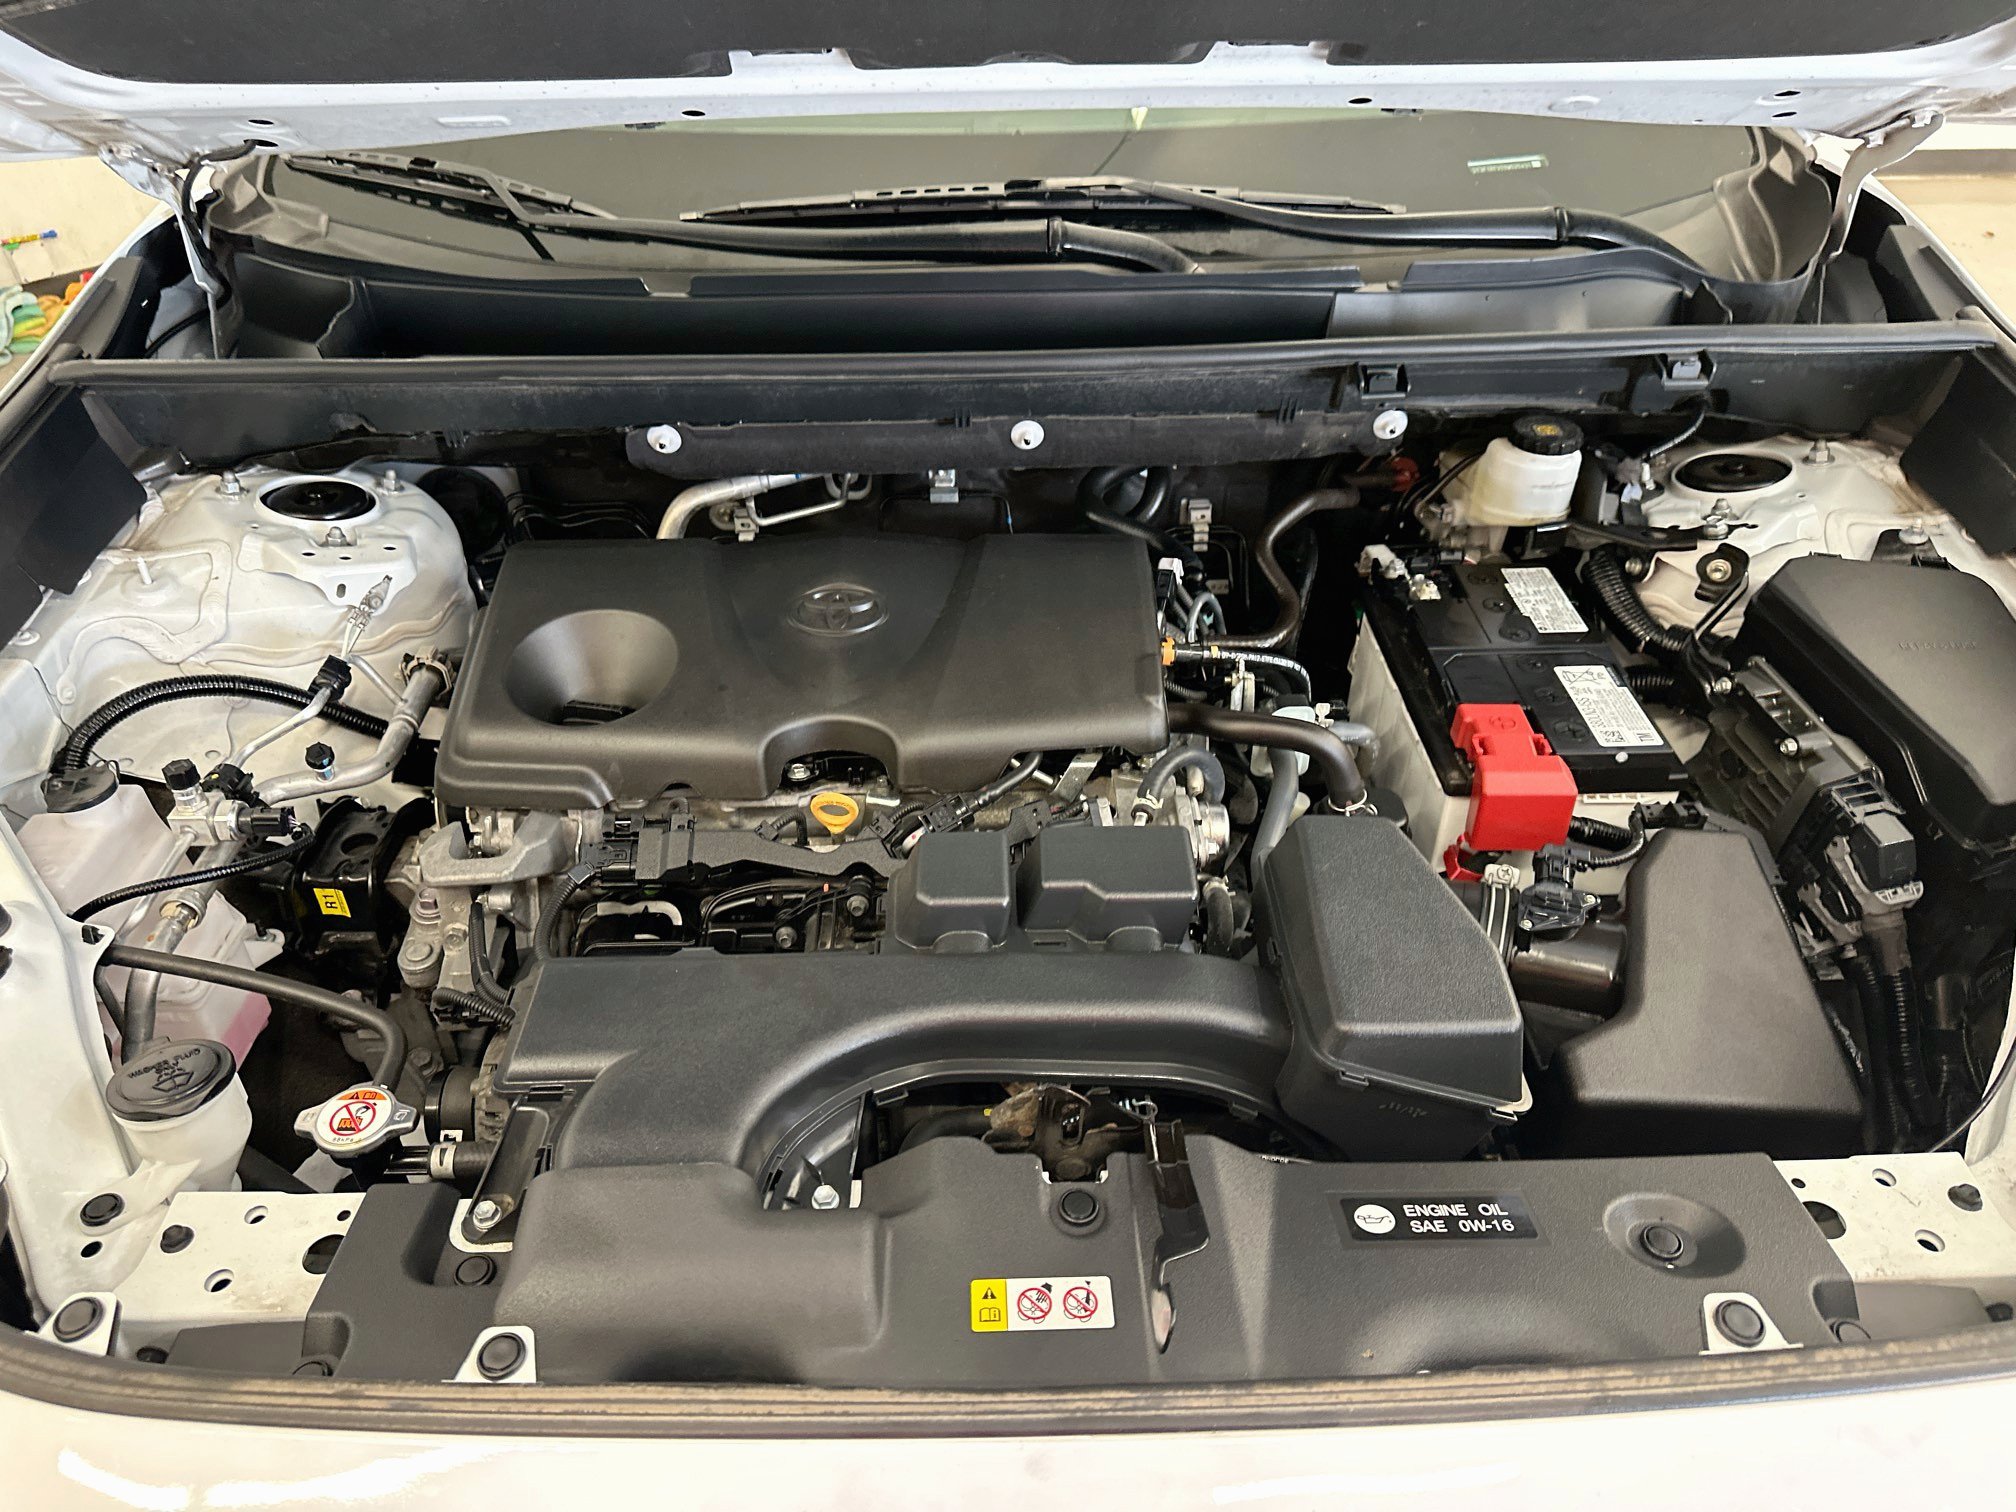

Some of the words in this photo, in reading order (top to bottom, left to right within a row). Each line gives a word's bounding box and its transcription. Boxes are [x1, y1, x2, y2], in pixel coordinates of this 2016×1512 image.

[323, 894, 338, 909] R1
[1403, 1204, 1469, 1217] ENGINE
[1478, 1203, 1509, 1217] OIL
[1410, 1220, 1448, 1233] SAE
[1458, 1219, 1515, 1233] 0W-16
